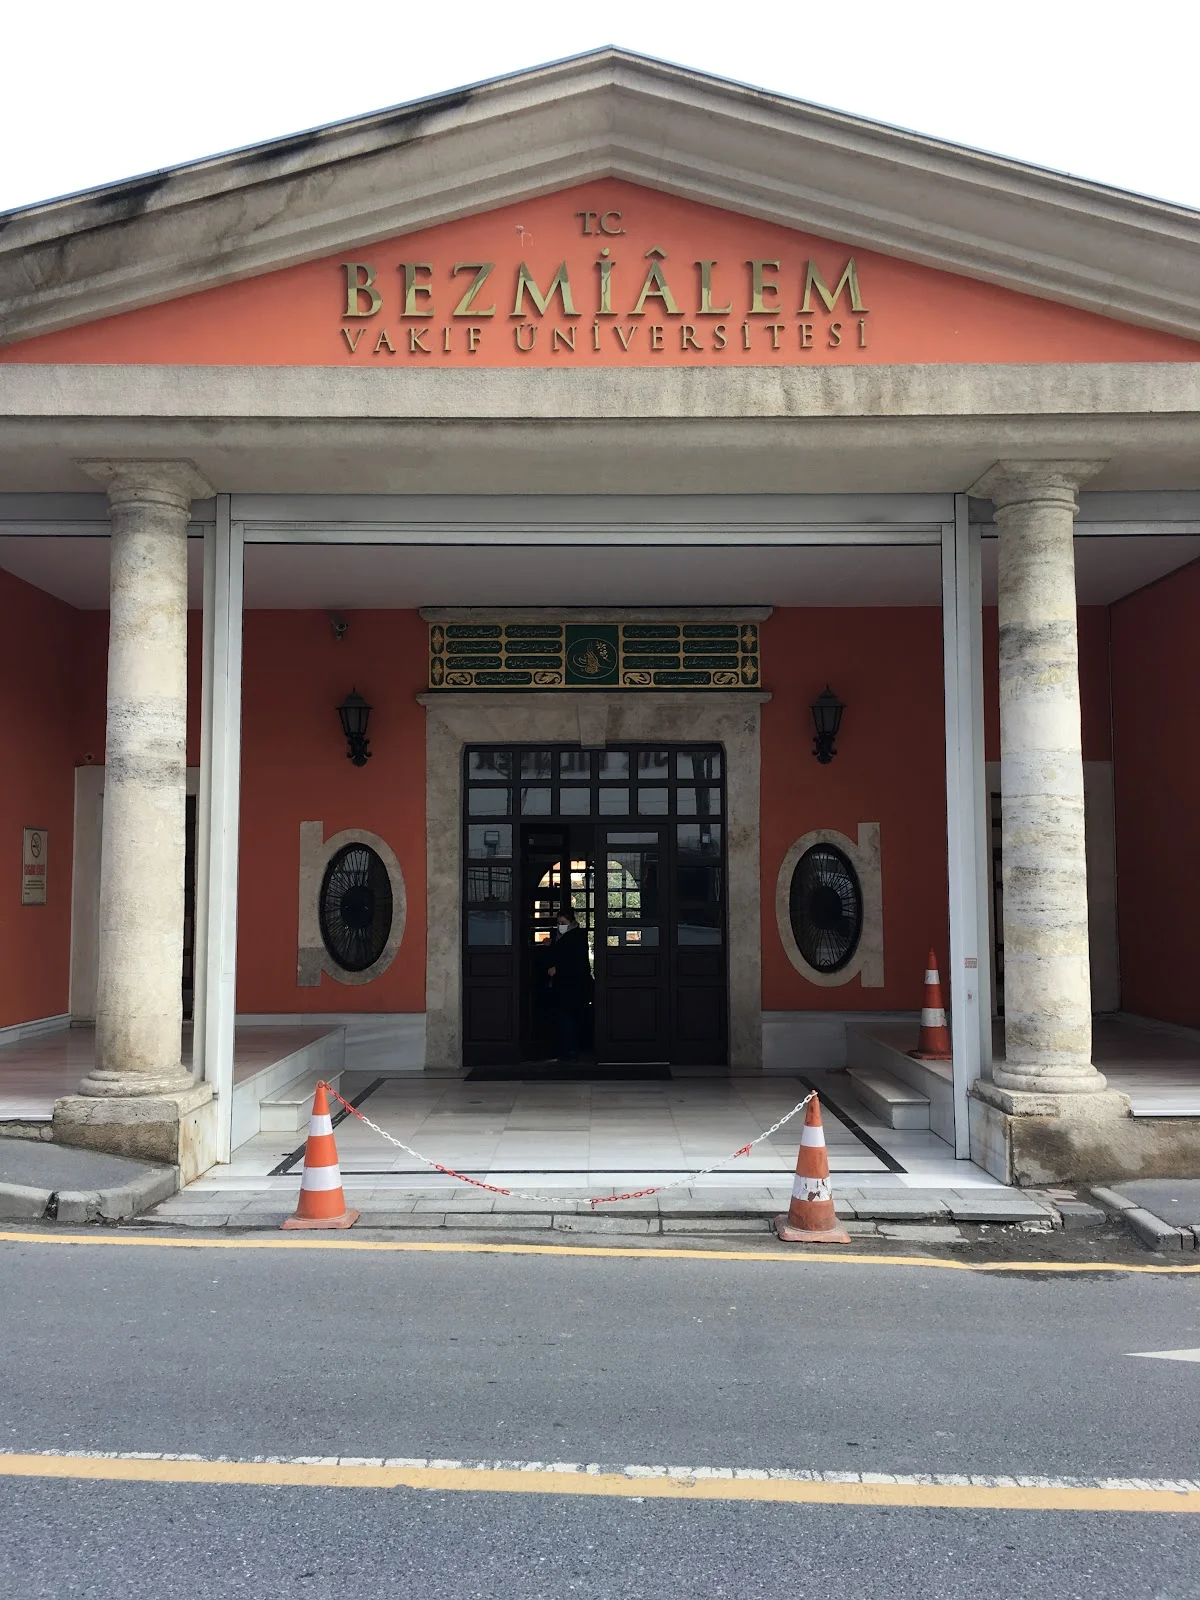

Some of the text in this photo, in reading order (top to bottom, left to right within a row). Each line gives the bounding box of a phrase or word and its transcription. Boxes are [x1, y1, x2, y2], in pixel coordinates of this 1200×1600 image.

[340, 246, 869, 318] BEZMİÂLEM
[341, 318, 868, 354] VAKIF ÜNİVERSİTESİ
